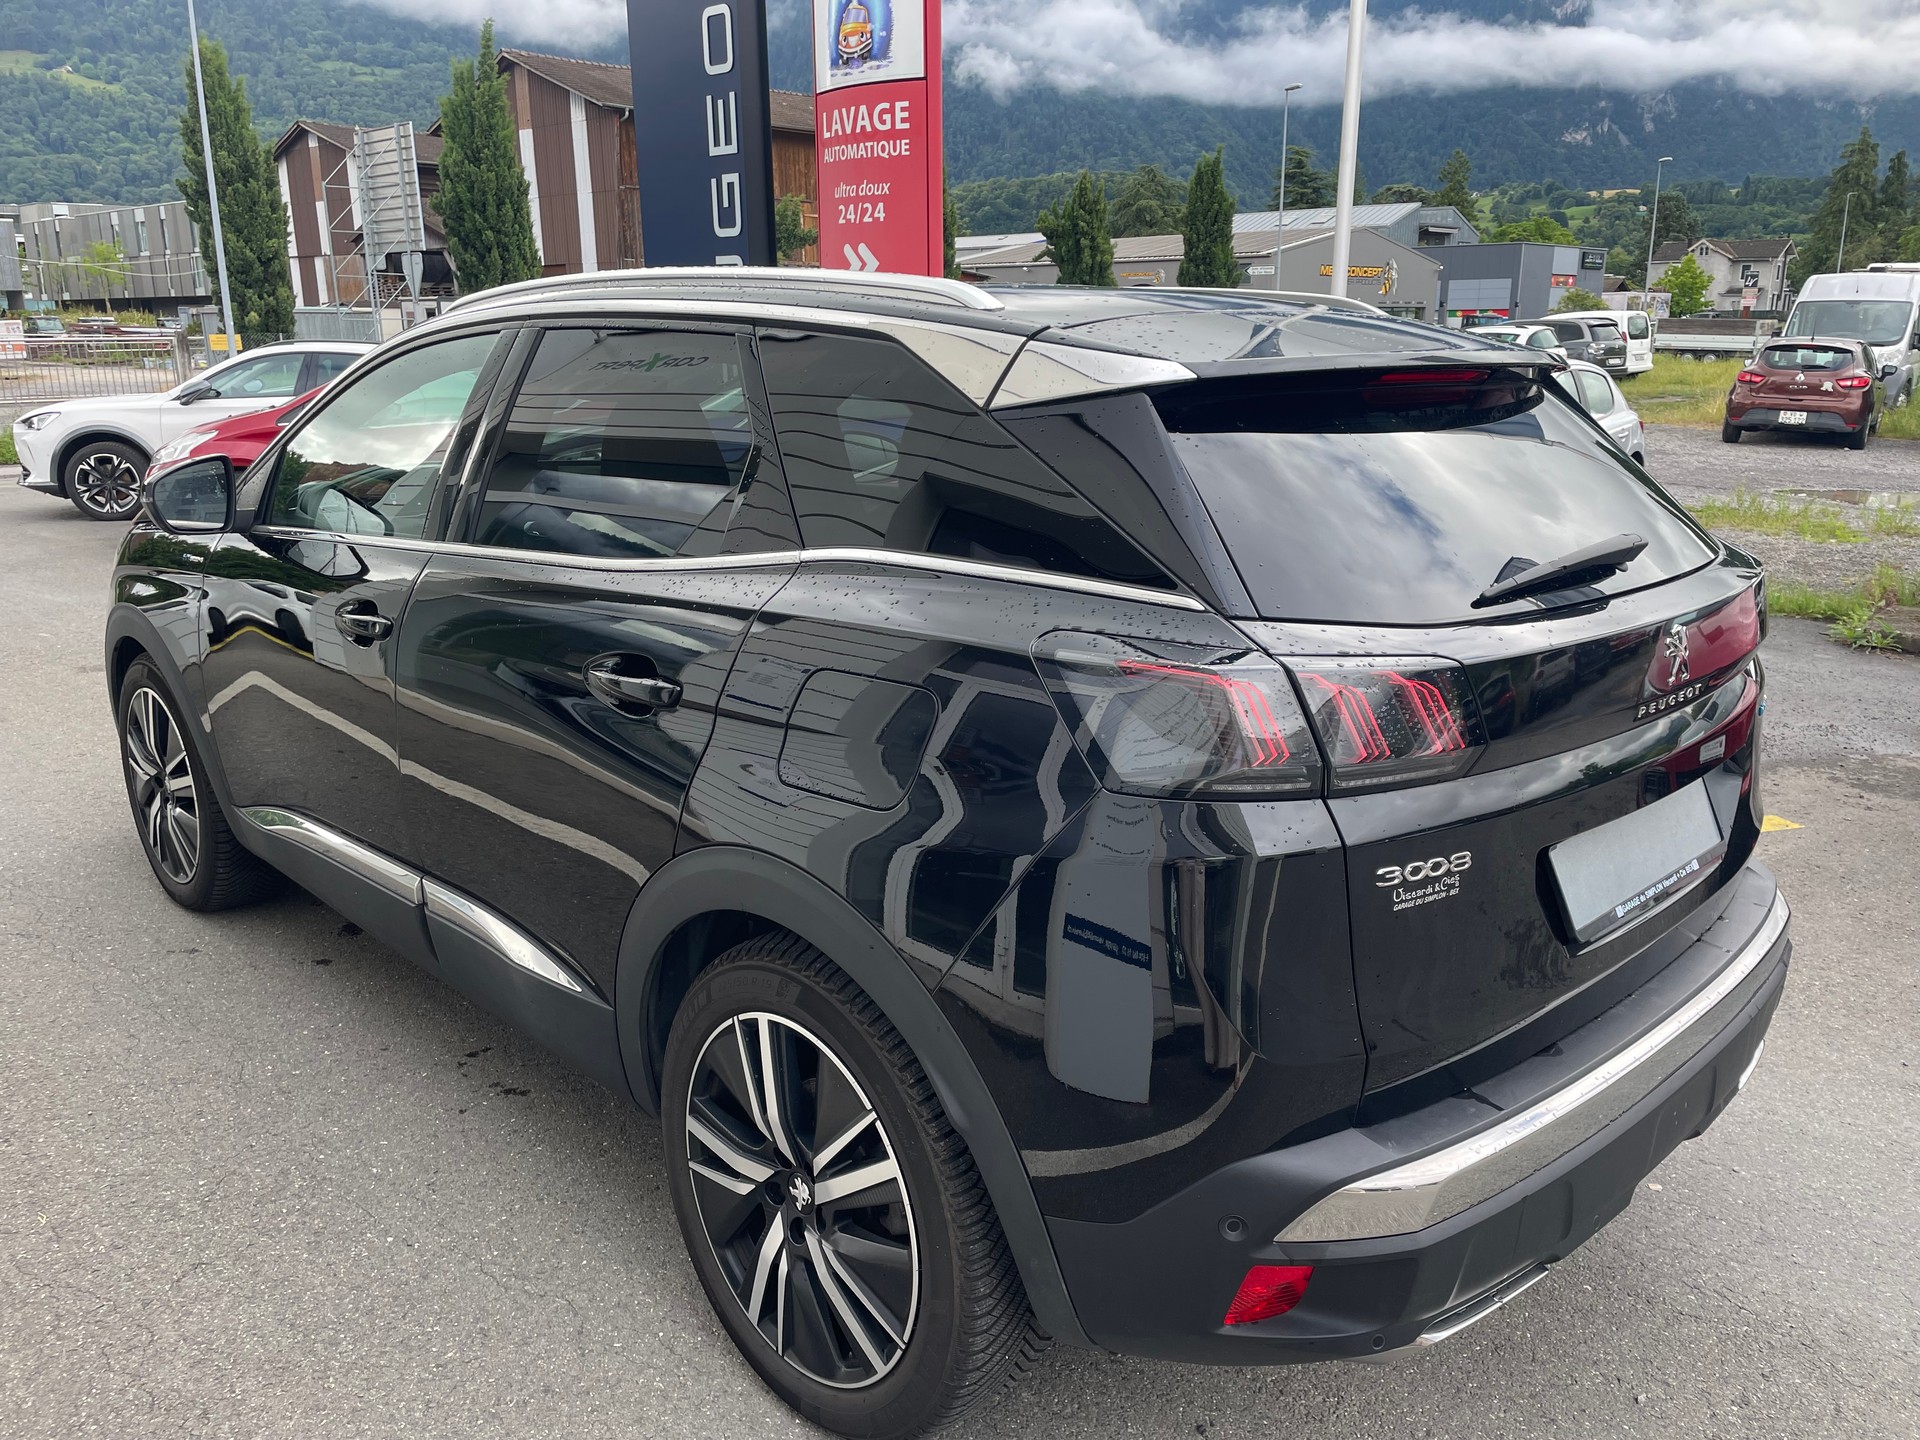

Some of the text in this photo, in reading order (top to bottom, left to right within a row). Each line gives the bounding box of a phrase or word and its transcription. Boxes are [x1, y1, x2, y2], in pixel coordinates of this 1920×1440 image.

[823, 101, 910, 139] LAVAGE
[823, 139, 910, 163] AUTOMATIQUE
[834, 179, 891, 198] ultra doux
[838, 202, 886, 224] 24/24
[1637, 683, 1703, 718] PEUGEOT
[1375, 851, 1472, 888] 3008
[1393, 884, 1433, 902] Viscardi
[1434, 882, 1441, 892] &
[1393, 899, 1415, 912] GARAGE
[1415, 898, 1424, 906] DU
[1424, 891, 1446, 903] SIMPLON
[1449, 887, 1460, 896] BEX
[1622, 896, 1641, 913] GARAGE
[1644, 882, 1664, 899] SIMPLON
